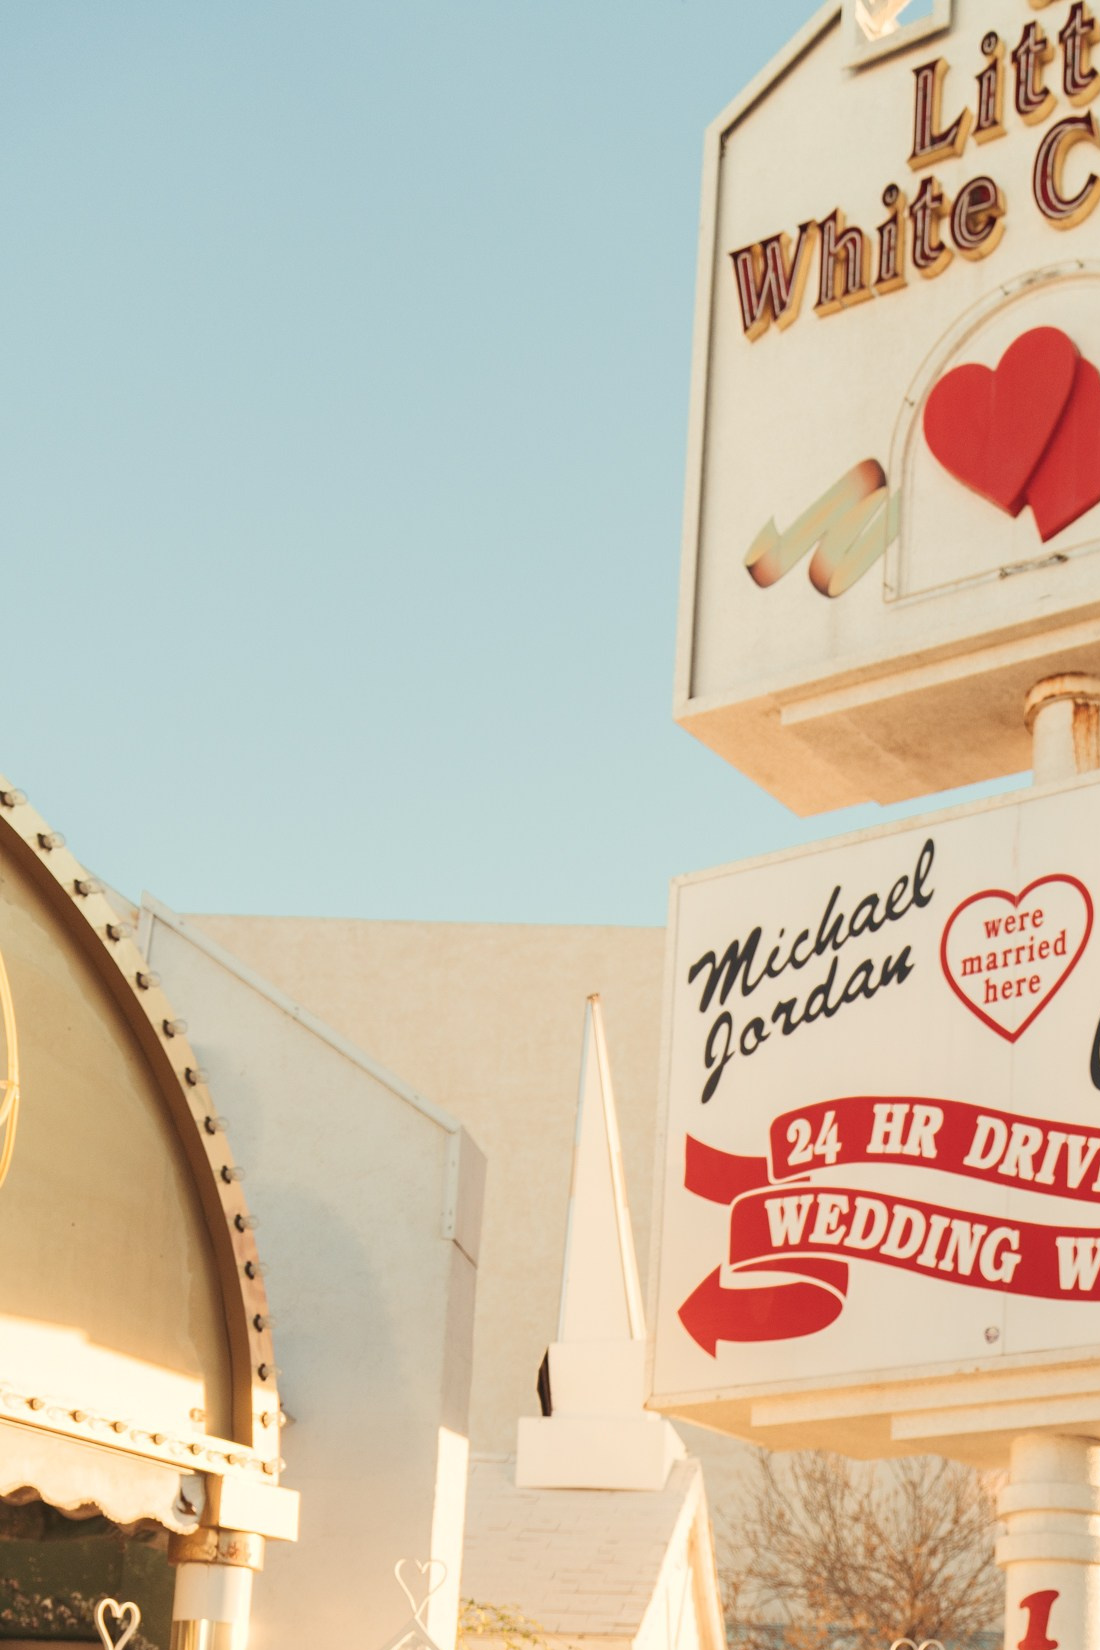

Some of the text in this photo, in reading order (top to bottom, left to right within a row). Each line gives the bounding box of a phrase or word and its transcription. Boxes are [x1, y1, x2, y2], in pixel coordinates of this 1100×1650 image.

[729, 175, 1005, 342] White
[688, 839, 936, 1013] Michael
[961, 930, 1067, 977] married
[984, 908, 1044, 939] were
[702, 946, 914, 1103] Jordan
[983, 975, 1041, 1005] here
[786, 1110, 842, 1166] 24
[866, 1103, 944, 1159] HR
[764, 1193, 1021, 1283] WEDDING
